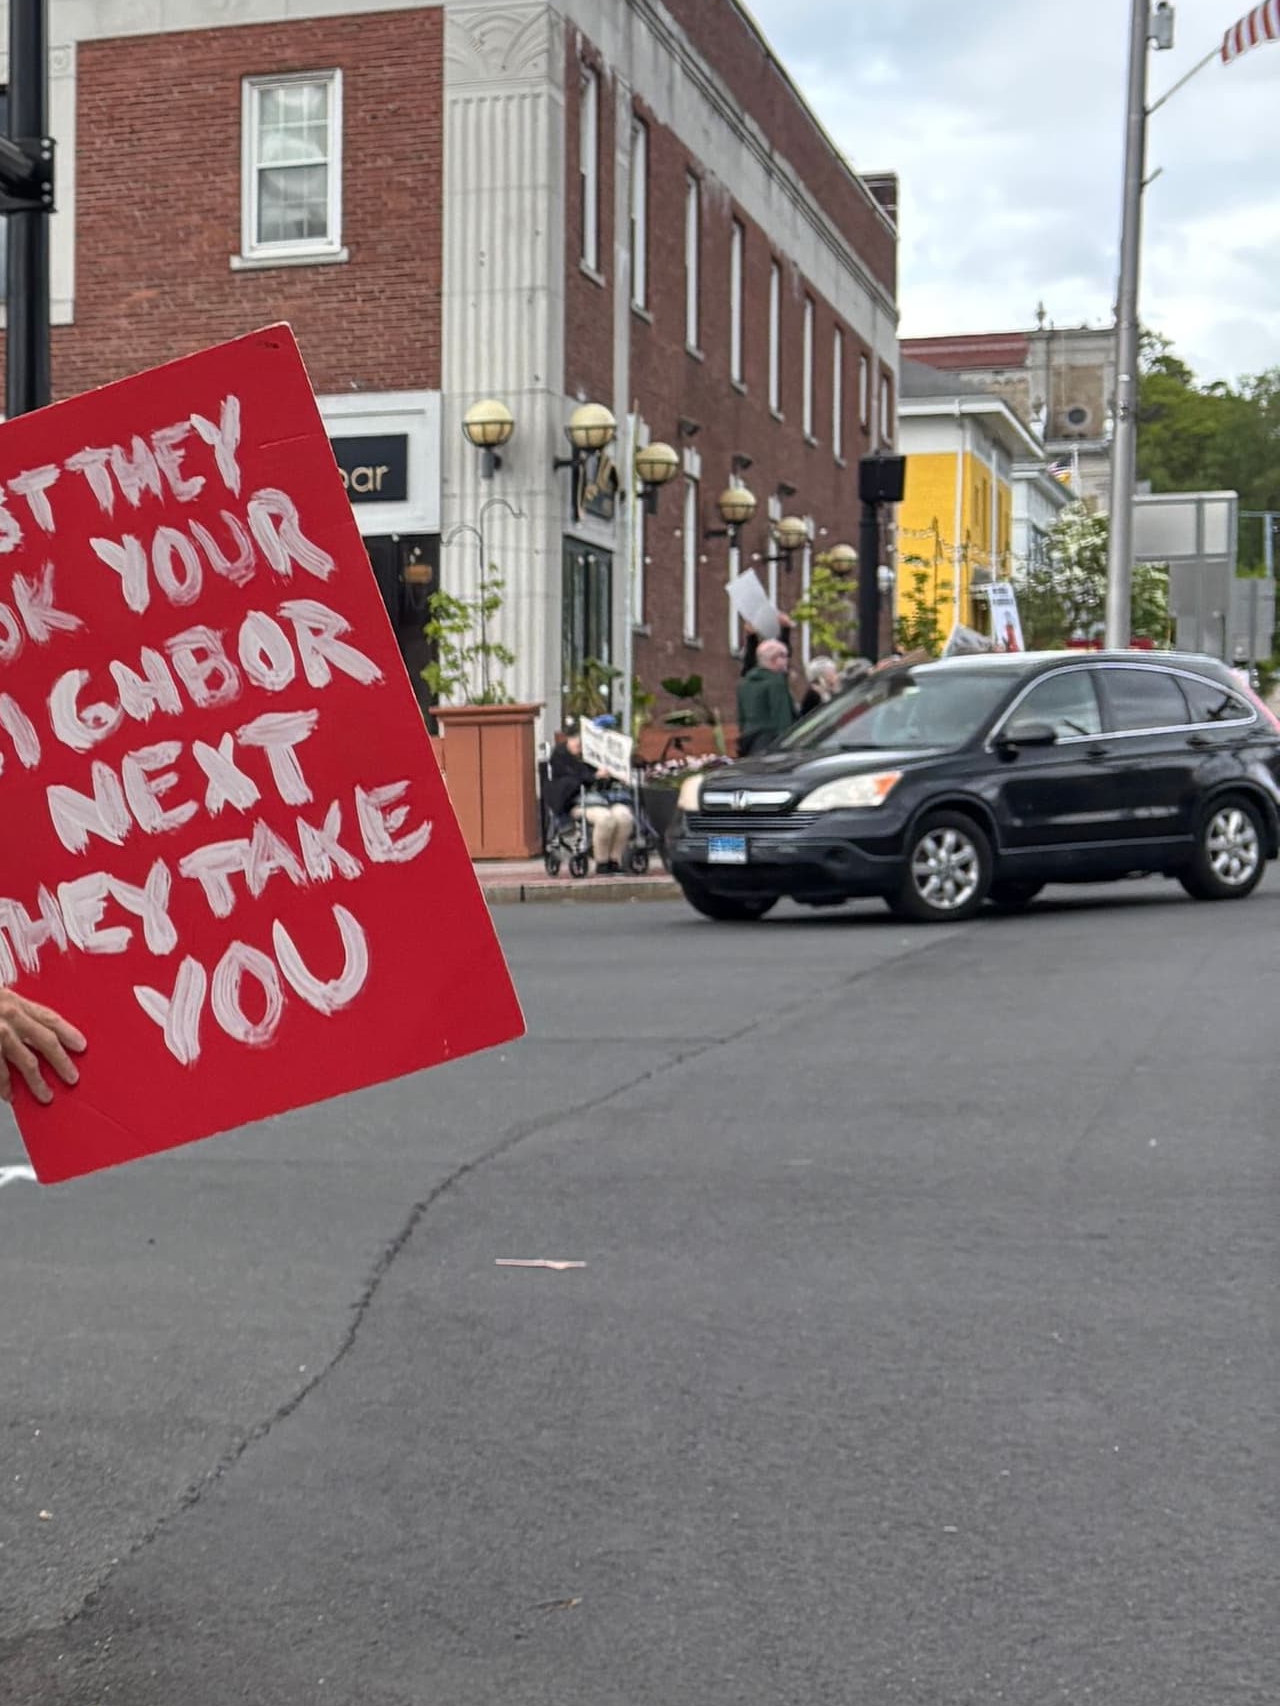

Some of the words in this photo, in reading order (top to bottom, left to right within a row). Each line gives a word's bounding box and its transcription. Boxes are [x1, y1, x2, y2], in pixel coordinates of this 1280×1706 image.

[65, 394, 241, 517] THEY
[90, 488, 337, 616] YOUR
[47, 708, 319, 855] NEXT
[178, 779, 432, 920] TAKE
[133, 904, 370, 1068] YOU
